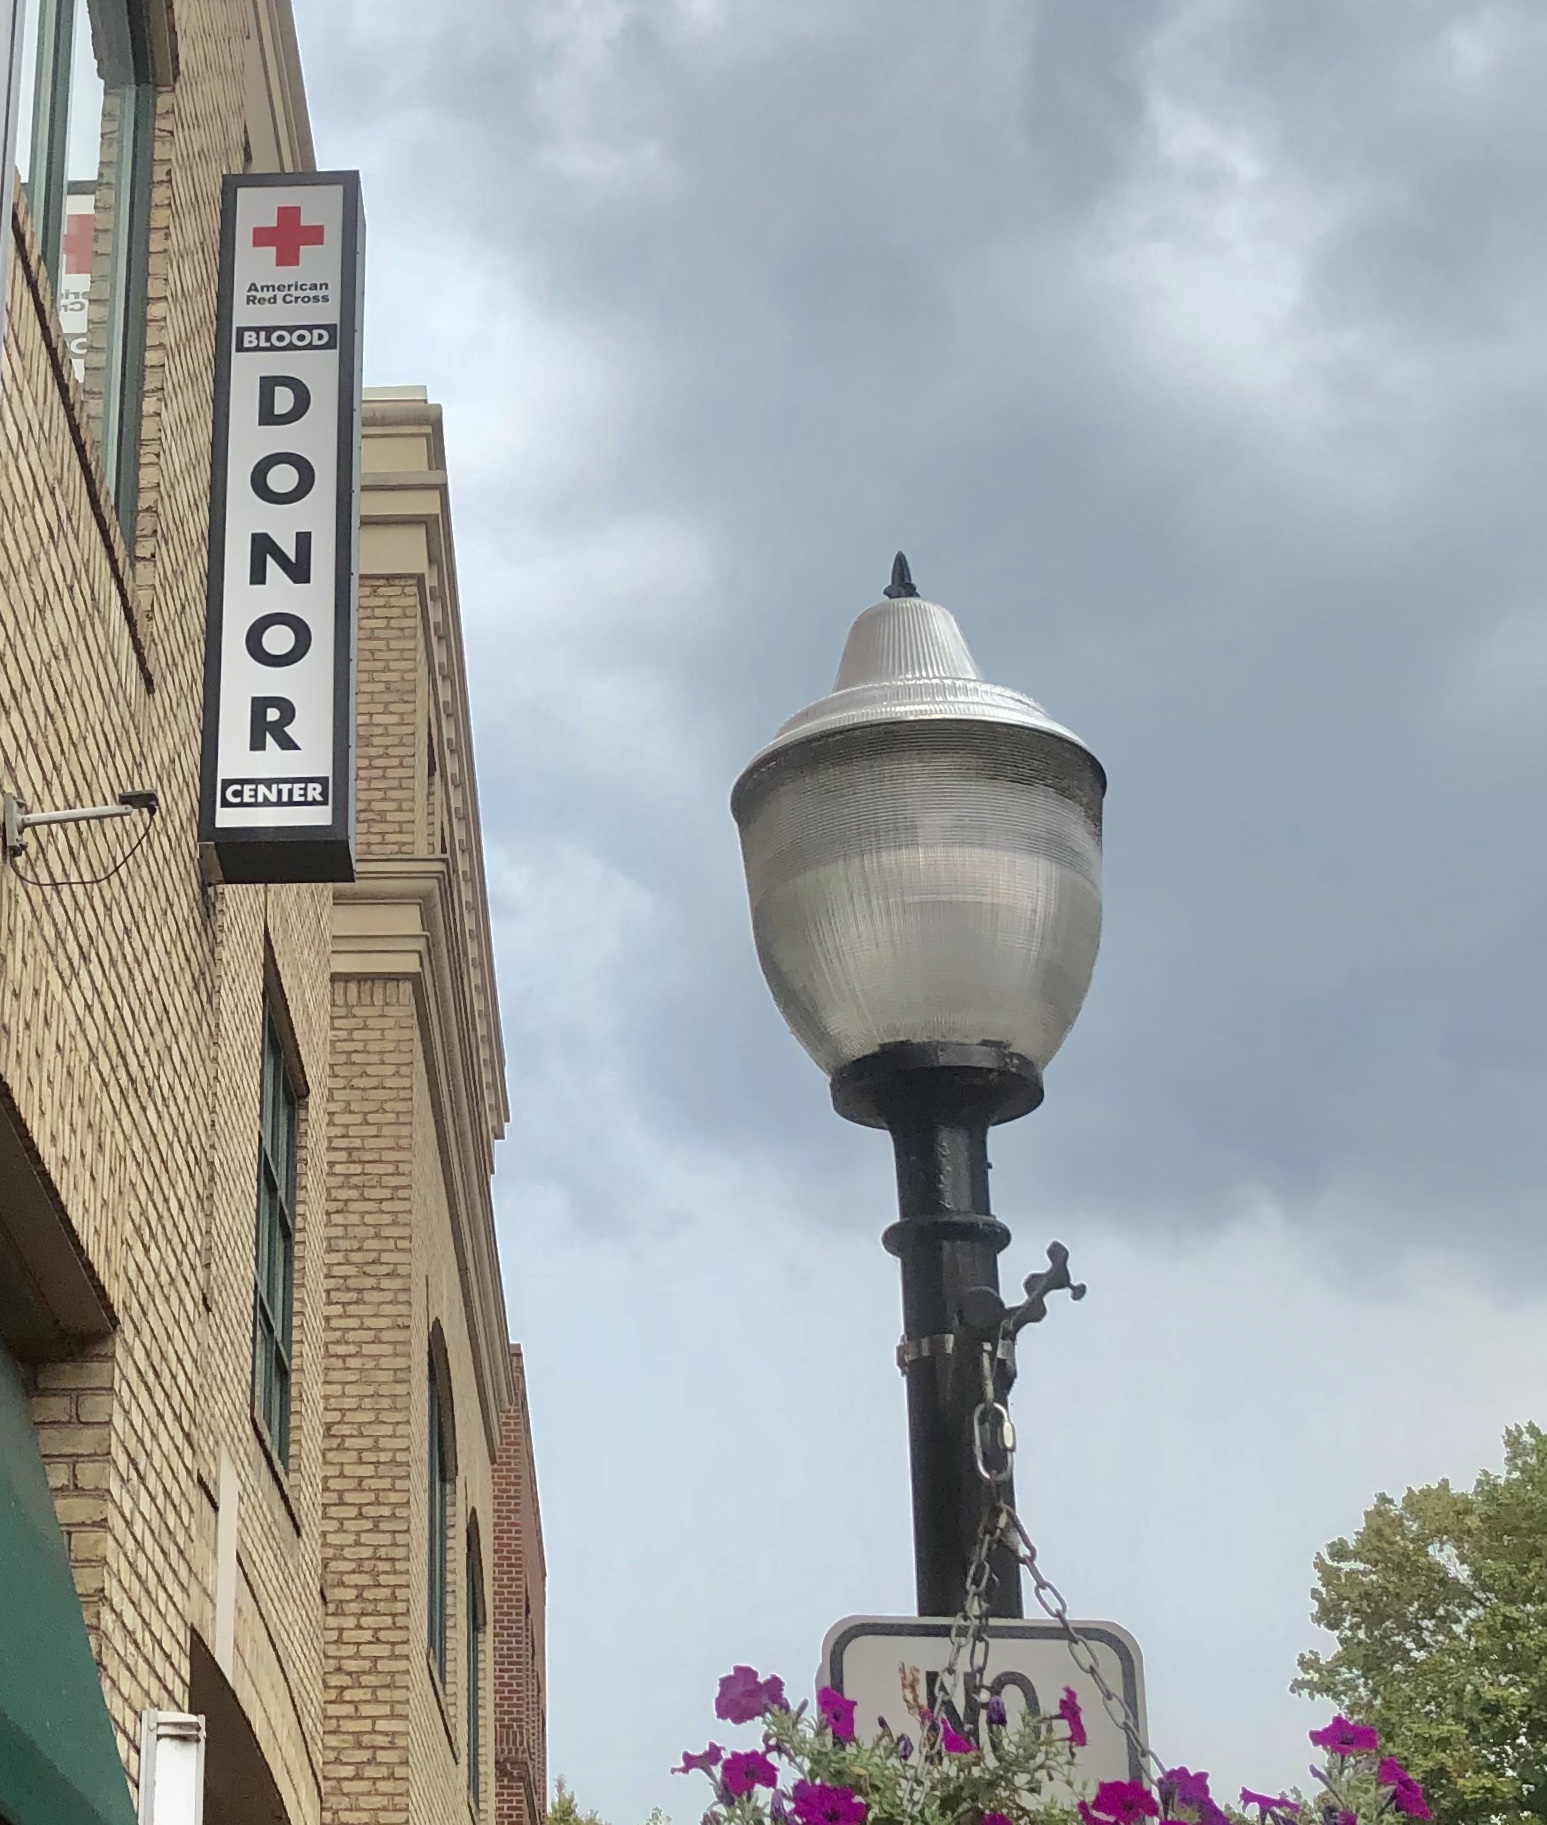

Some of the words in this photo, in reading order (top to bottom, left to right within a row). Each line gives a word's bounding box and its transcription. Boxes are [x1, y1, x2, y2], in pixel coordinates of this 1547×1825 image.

[246, 281, 329, 293] American
[246, 294, 278, 305] Red
[282, 293, 330, 304] Cross
[243, 329, 329, 348] BLOOD
[246, 376, 315, 751] DONOR
[225, 782, 324, 804] CENTER
